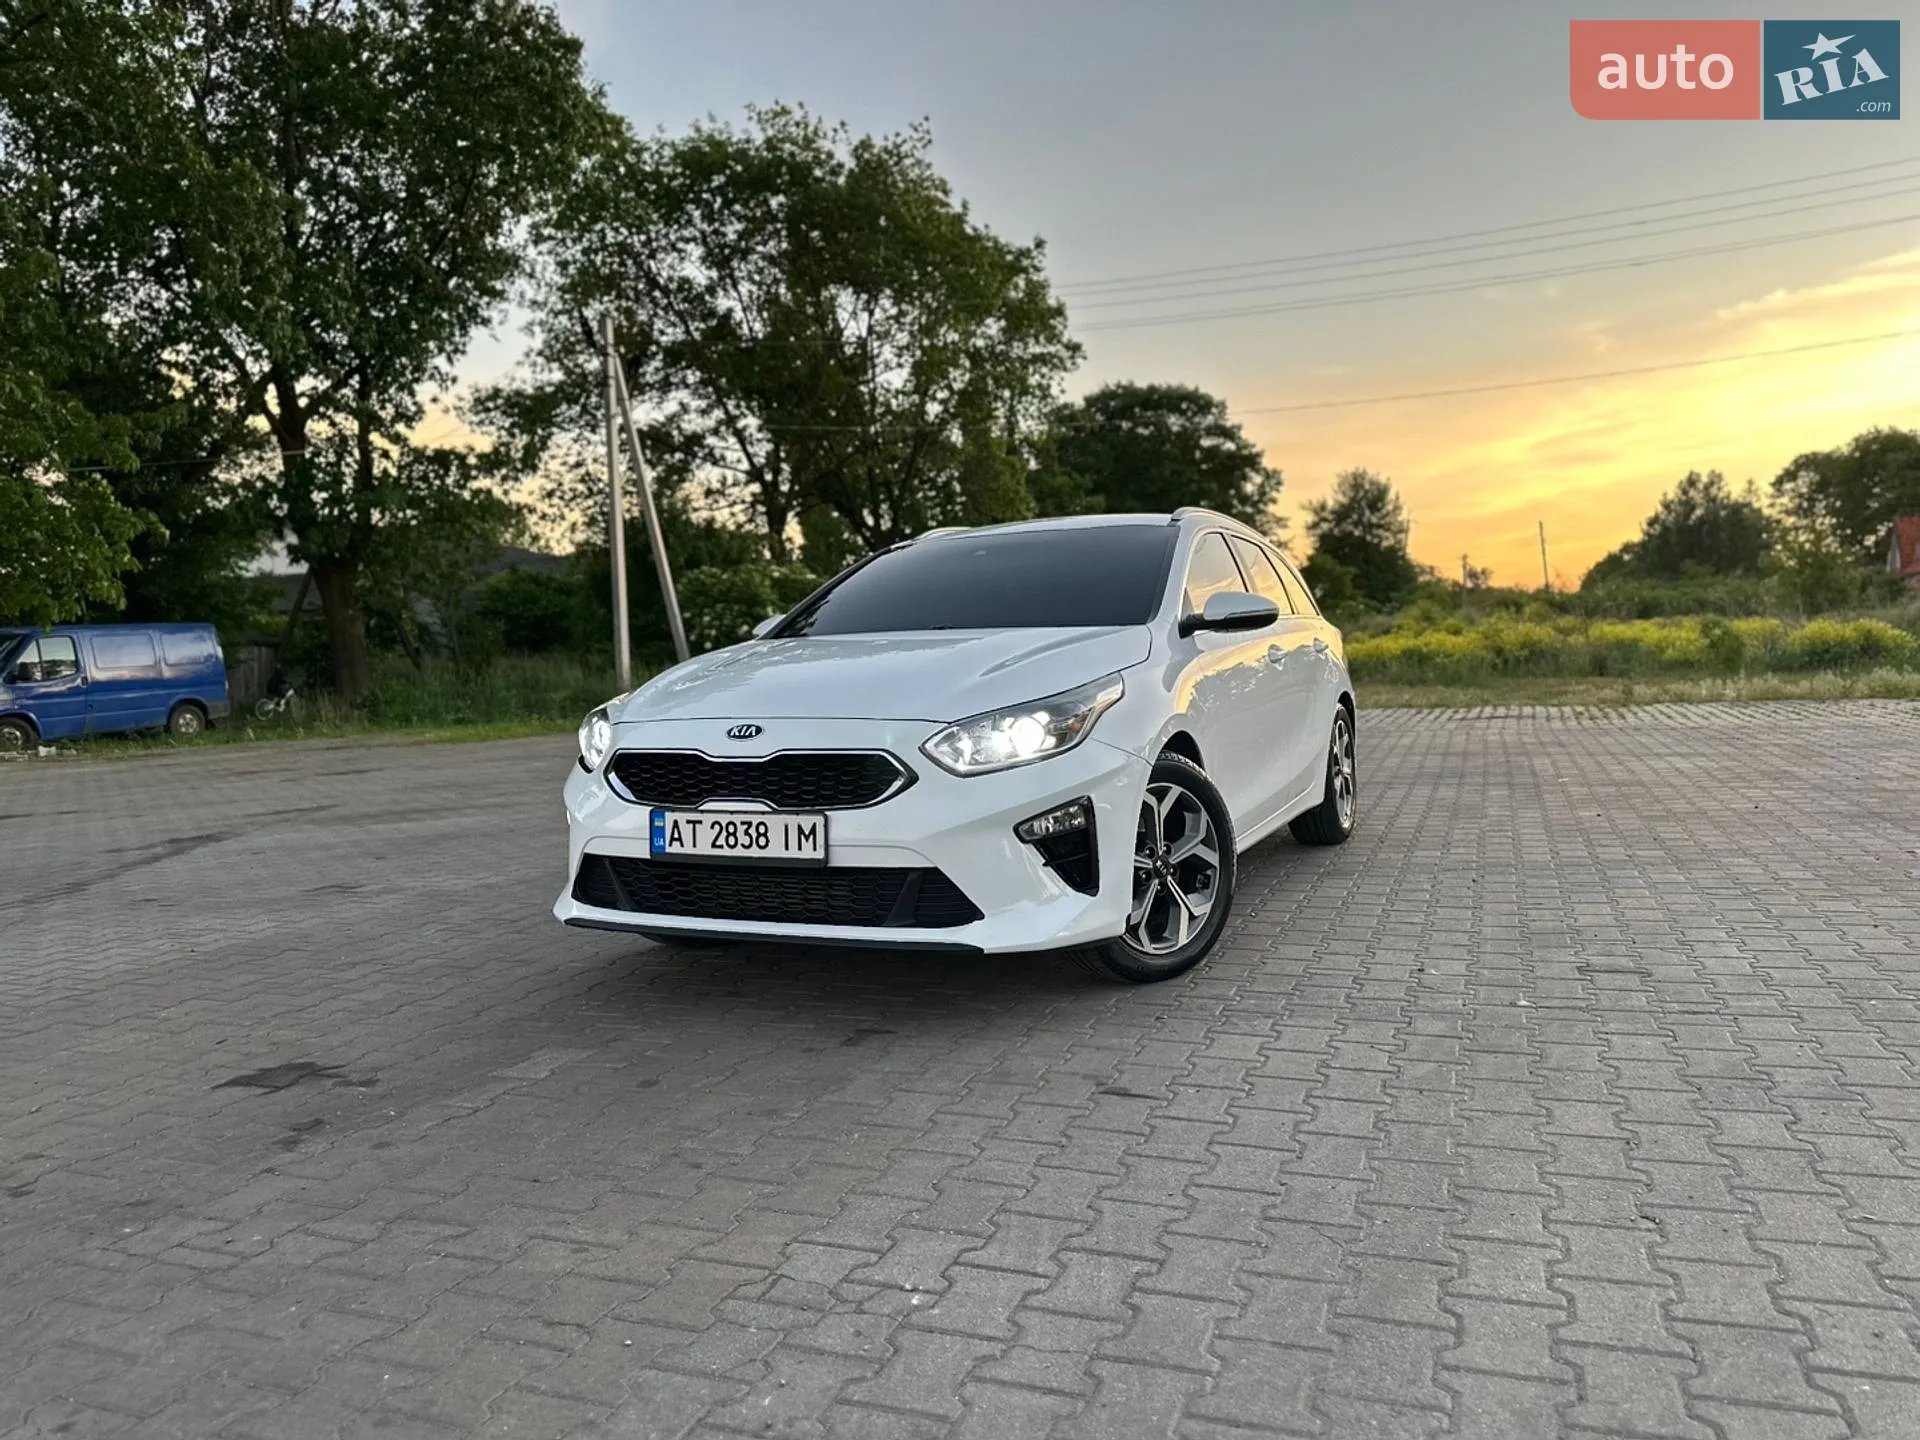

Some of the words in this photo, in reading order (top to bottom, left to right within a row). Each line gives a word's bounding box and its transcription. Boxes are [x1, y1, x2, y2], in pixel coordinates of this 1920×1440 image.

[730, 725, 756, 736] KIA
[669, 819, 703, 848] AT
[710, 821, 770, 849] 2838
[784, 822, 817, 852] IM
[653, 837, 664, 846] UA
